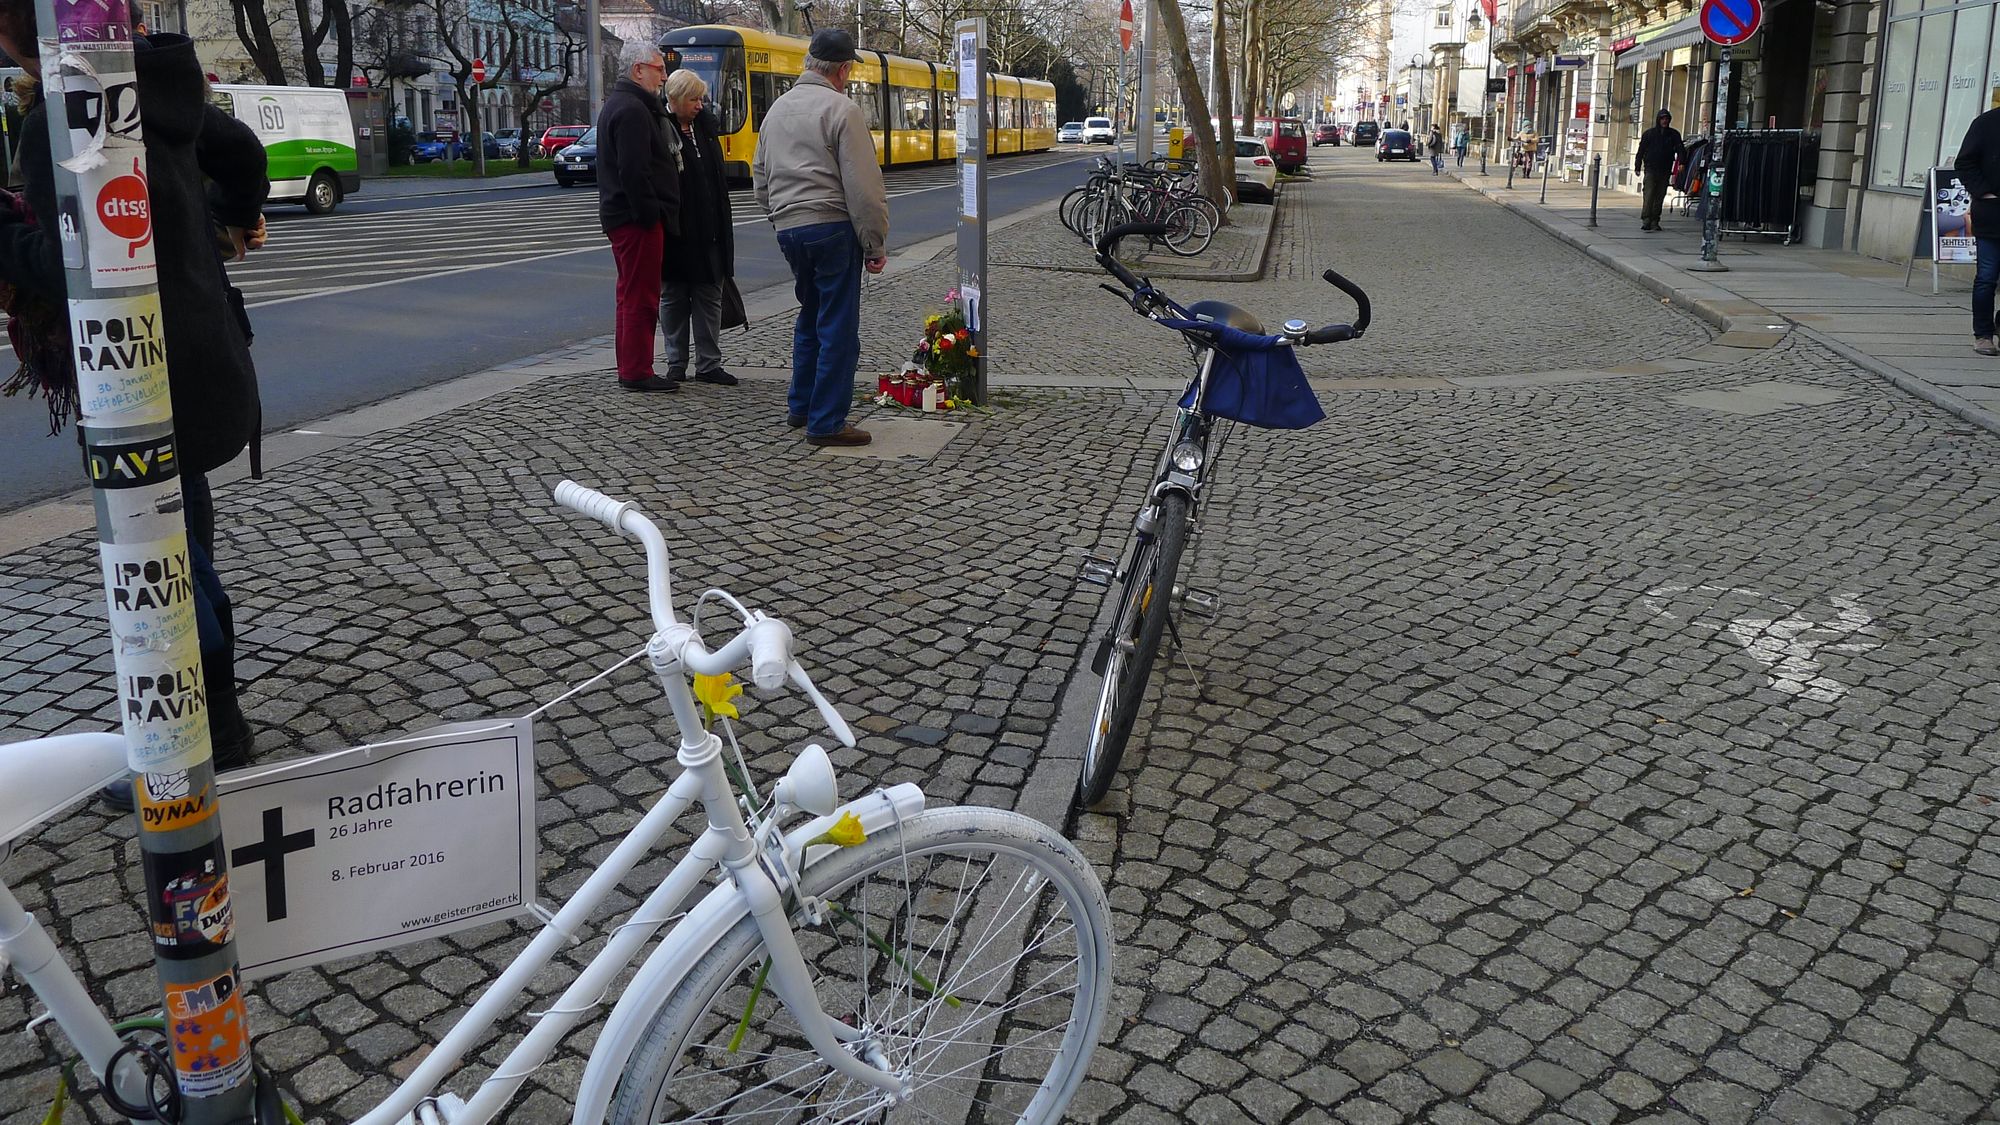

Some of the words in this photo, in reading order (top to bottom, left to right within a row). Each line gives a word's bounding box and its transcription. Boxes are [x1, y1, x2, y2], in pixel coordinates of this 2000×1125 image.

[754, 52, 769, 64] DVB
[257, 104, 285, 130] ISD
[103, 197, 148, 219] dtsg
[79, 313, 155, 345] IPOLY
[92, 443, 174, 480] DAVE
[115, 550, 186, 587] IPOLY
[129, 662, 199, 698] IPOLY
[328, 771, 504, 819] Radfahrerin
[329, 825, 348, 840] 26
[353, 818, 393, 835] Jahre
[331, 869, 345, 882] 8.
[350, 859, 406, 878] Februar
[409, 851, 445, 867] 2016
[401, 892, 519, 929] www.geisterraeder.tk
